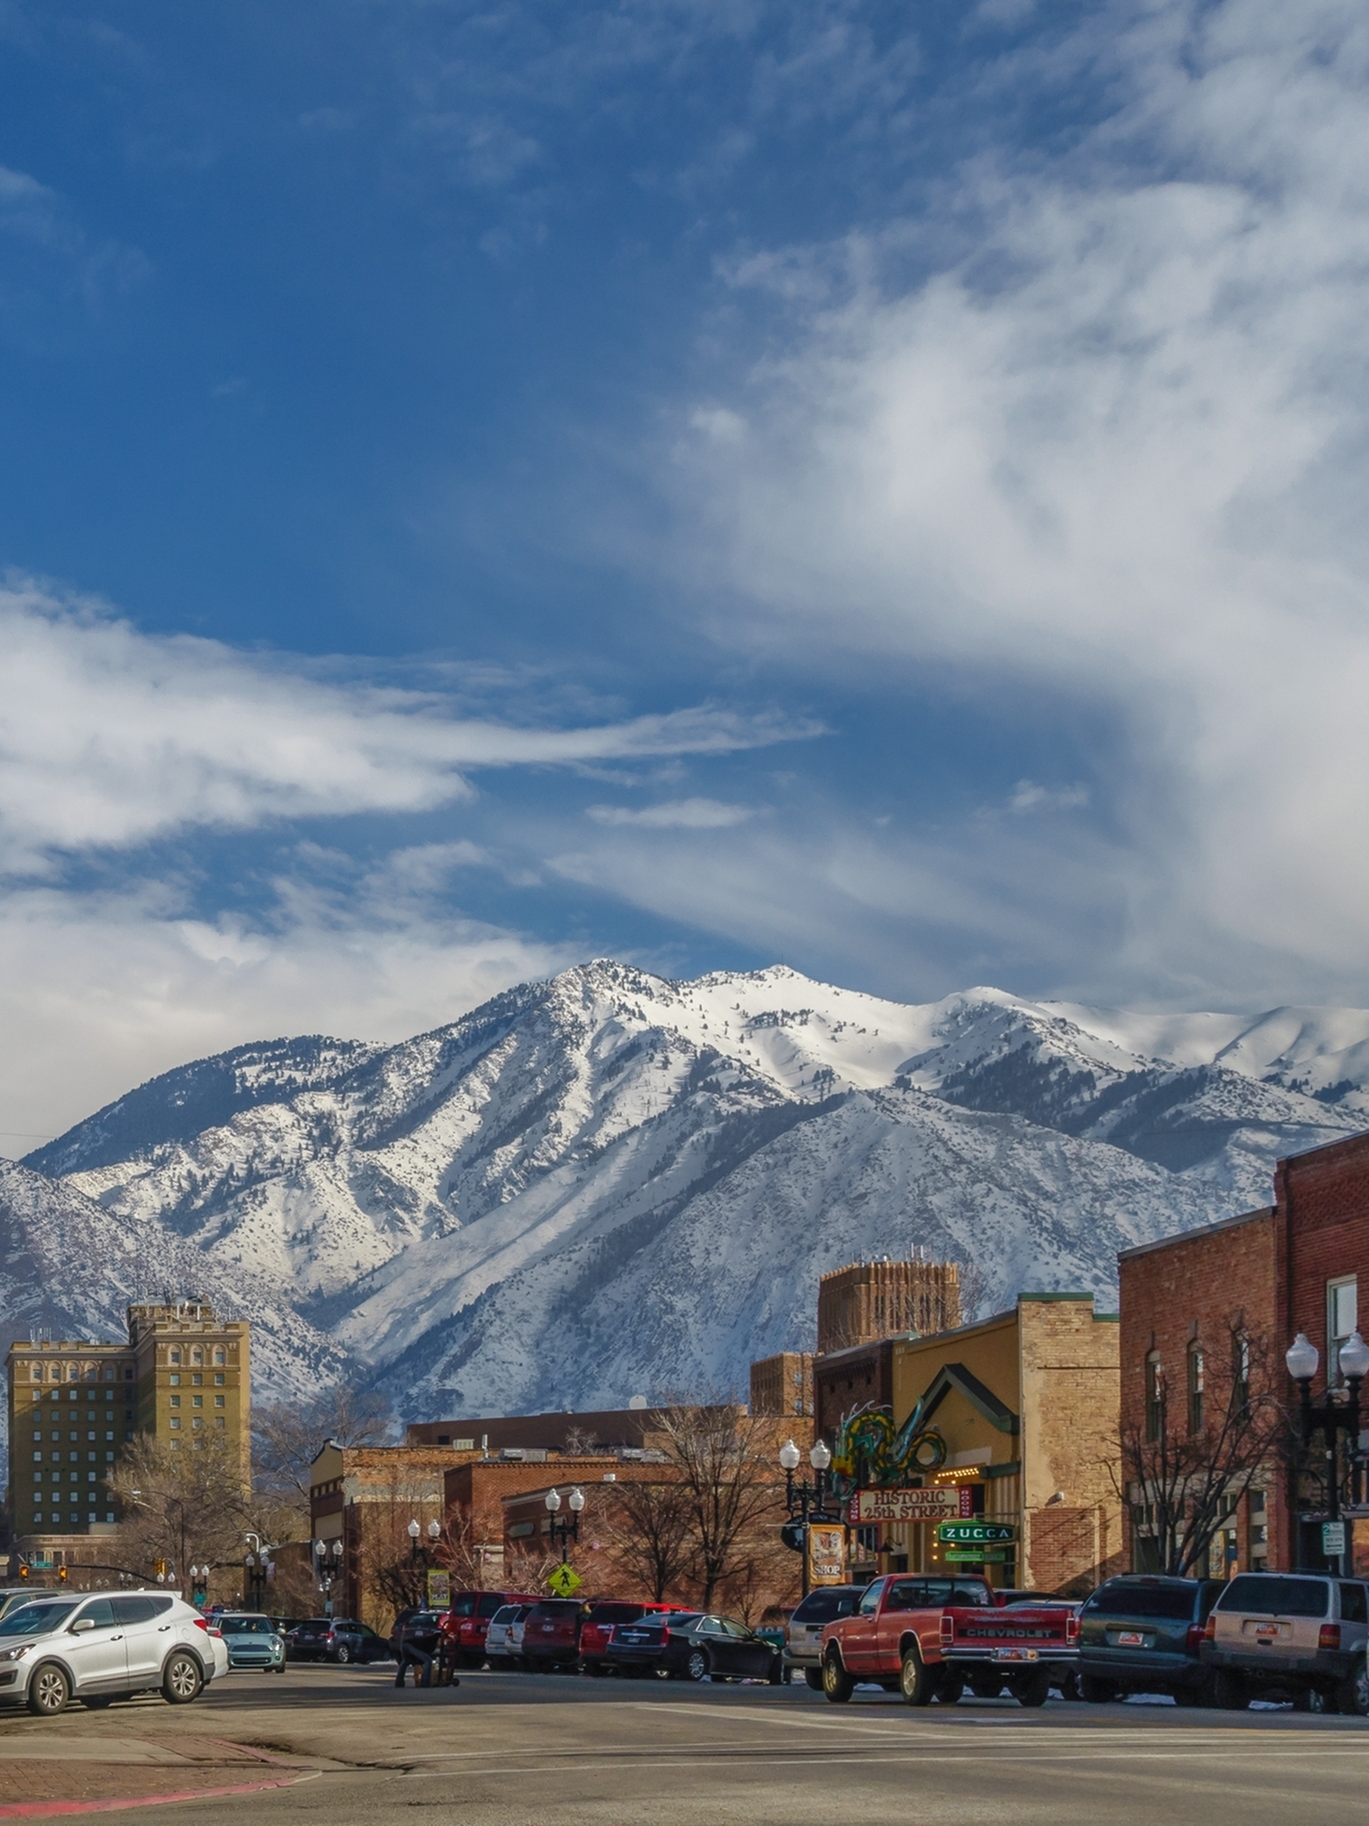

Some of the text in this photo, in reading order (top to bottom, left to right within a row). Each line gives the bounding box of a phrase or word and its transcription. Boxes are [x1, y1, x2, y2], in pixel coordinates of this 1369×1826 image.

[874, 1490, 946, 1505] HISTORIC
[961, 1490, 970, 1517] ROOMS
[864, 1504, 958, 1520] 25th STREET
[946, 1528, 1009, 1538] ZUCCA
[814, 1565, 841, 1575] SHOP
[967, 1628, 1052, 1638] CHEVROLET
